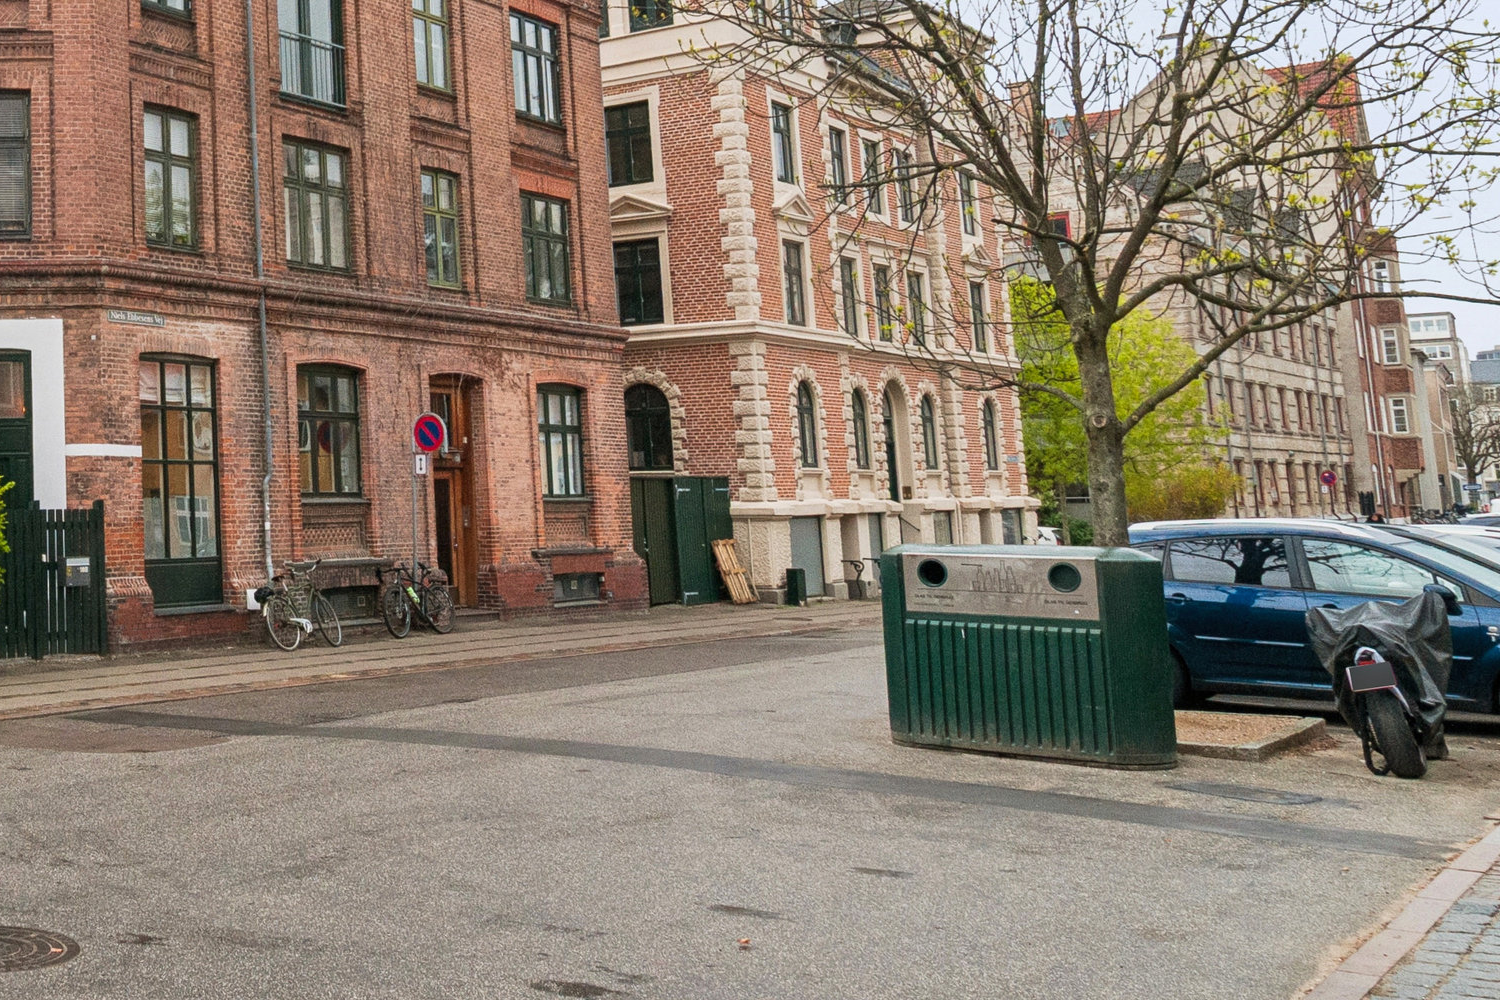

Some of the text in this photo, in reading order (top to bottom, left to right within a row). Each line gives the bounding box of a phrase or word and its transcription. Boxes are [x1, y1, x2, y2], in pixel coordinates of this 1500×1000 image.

[110, 310, 164, 326] Niels Ebbesens Vej
